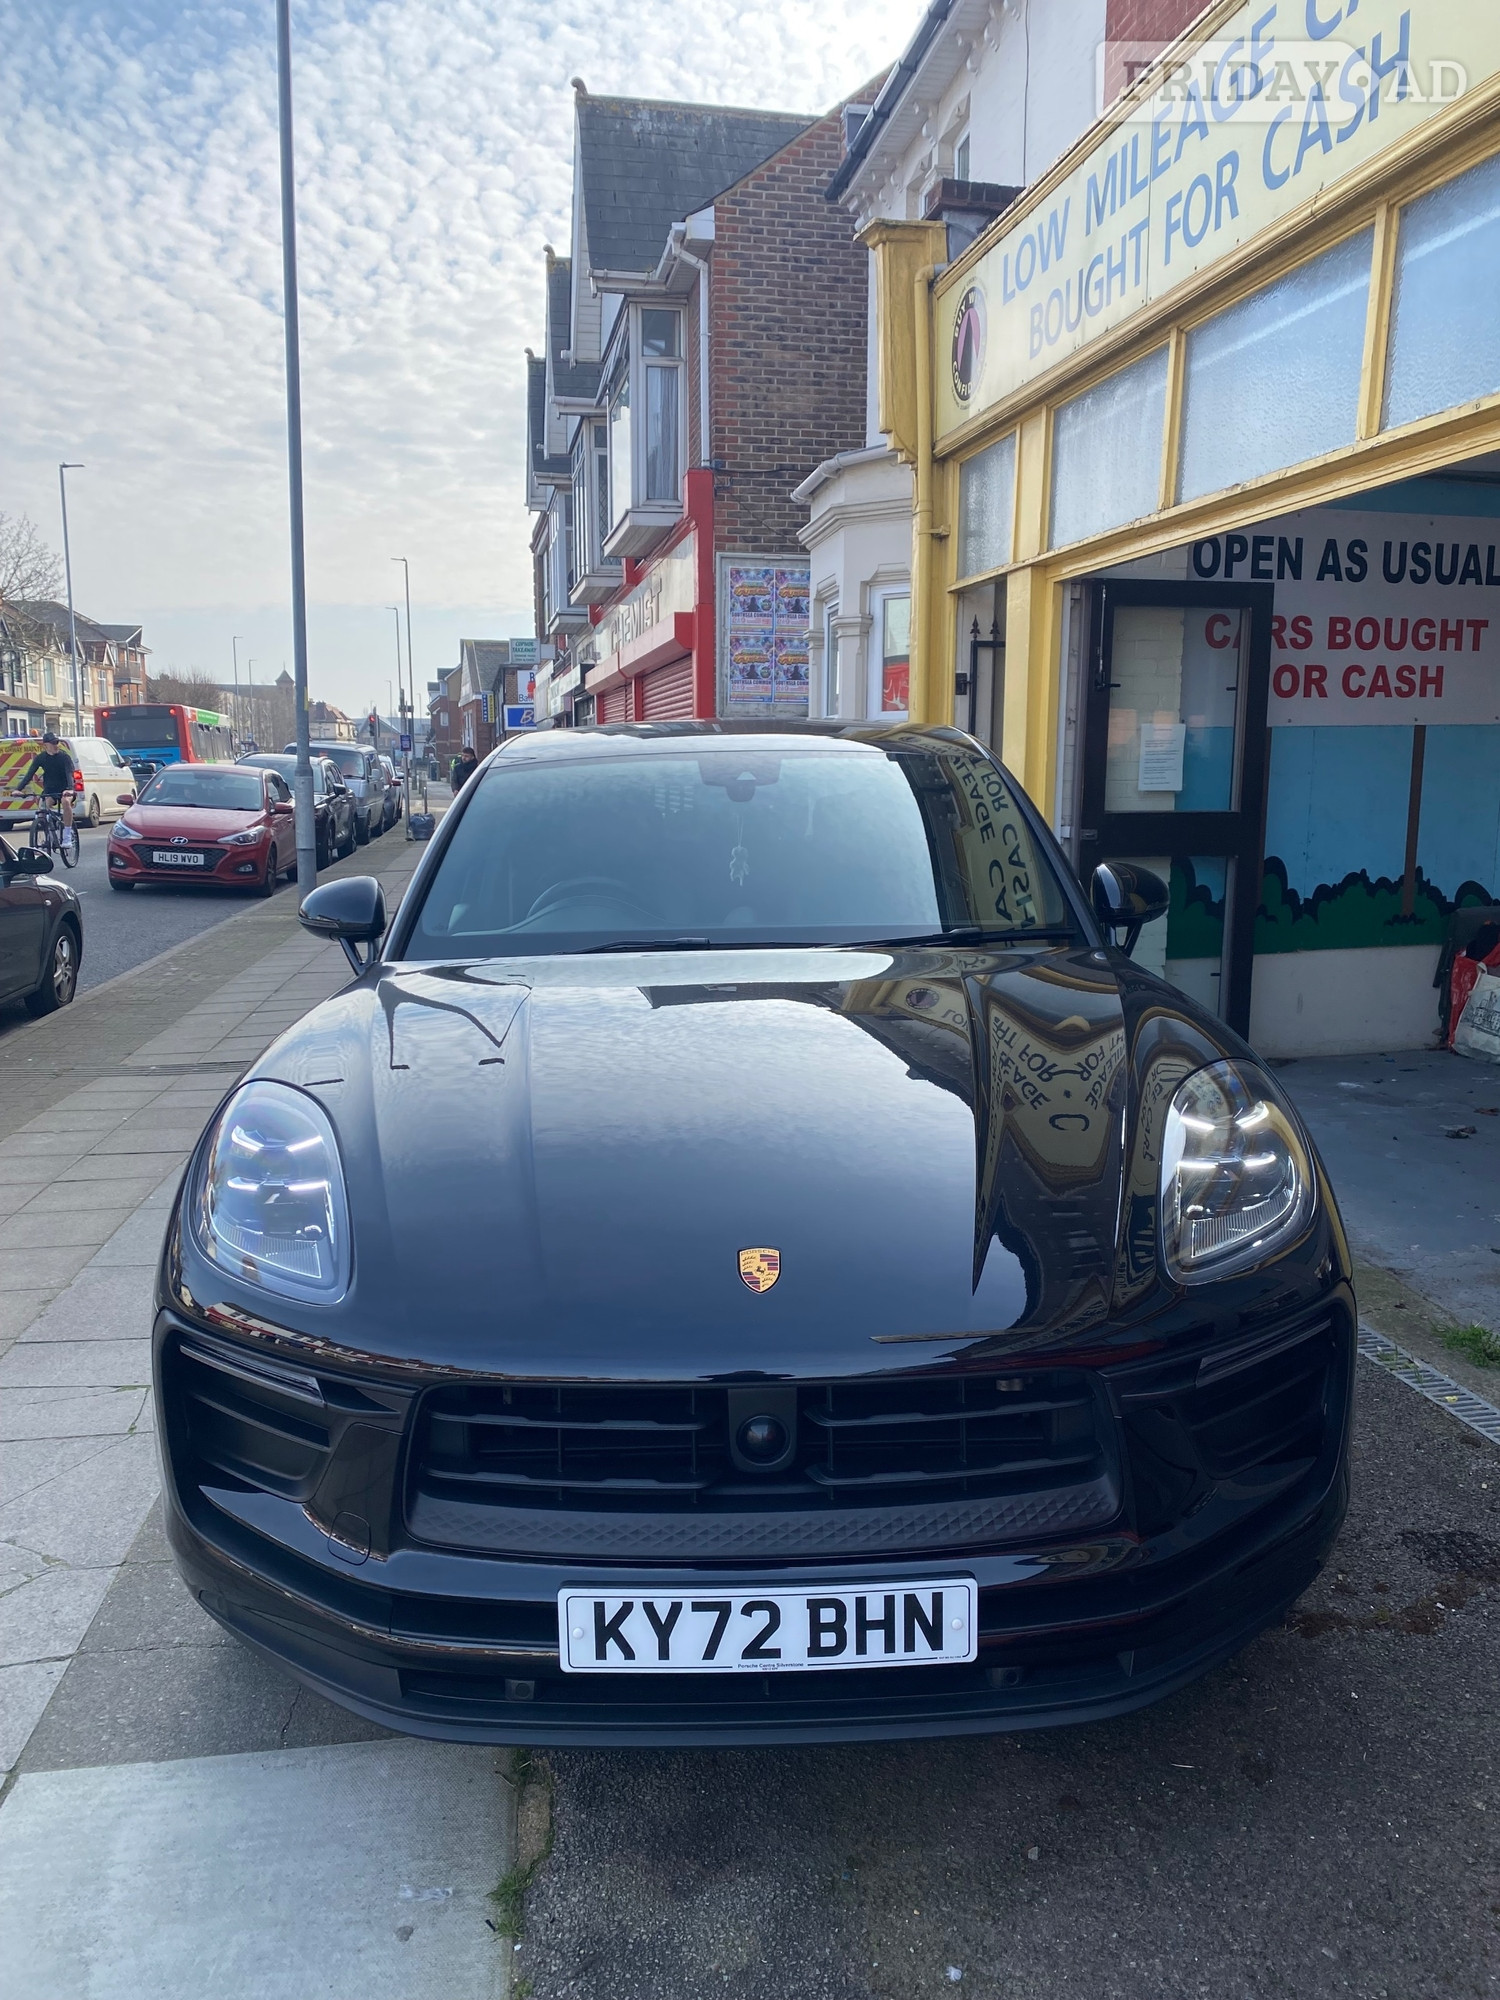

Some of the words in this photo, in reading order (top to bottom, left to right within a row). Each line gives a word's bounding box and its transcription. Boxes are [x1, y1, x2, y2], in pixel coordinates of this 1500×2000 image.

[1002, 196, 1071, 306] LOW
[1085, 3, 1277, 237] MILEAGE
[1029, 216, 1149, 360] BOUGHT
[1164, 150, 1240, 266] FOR
[1262, 9, 1411, 190] CASH
[1193, 535, 1303, 580] OPEN
[1316, 538, 1368, 583] AS
[1382, 541, 1500, 586] USUAL
[611, 576, 662, 656] CHEMIST
[1205, 613, 1313, 650] CRS
[1327, 616, 1489, 652] BOUGHT
[1272, 664, 1328, 698] OR
[1342, 664, 1444, 698] CASH
[158, 853, 179, 863] HL19
[180, 855, 199, 864] WVO
[593, 1600, 782, 1661] KY72
[807, 1592, 944, 1657] BHN
